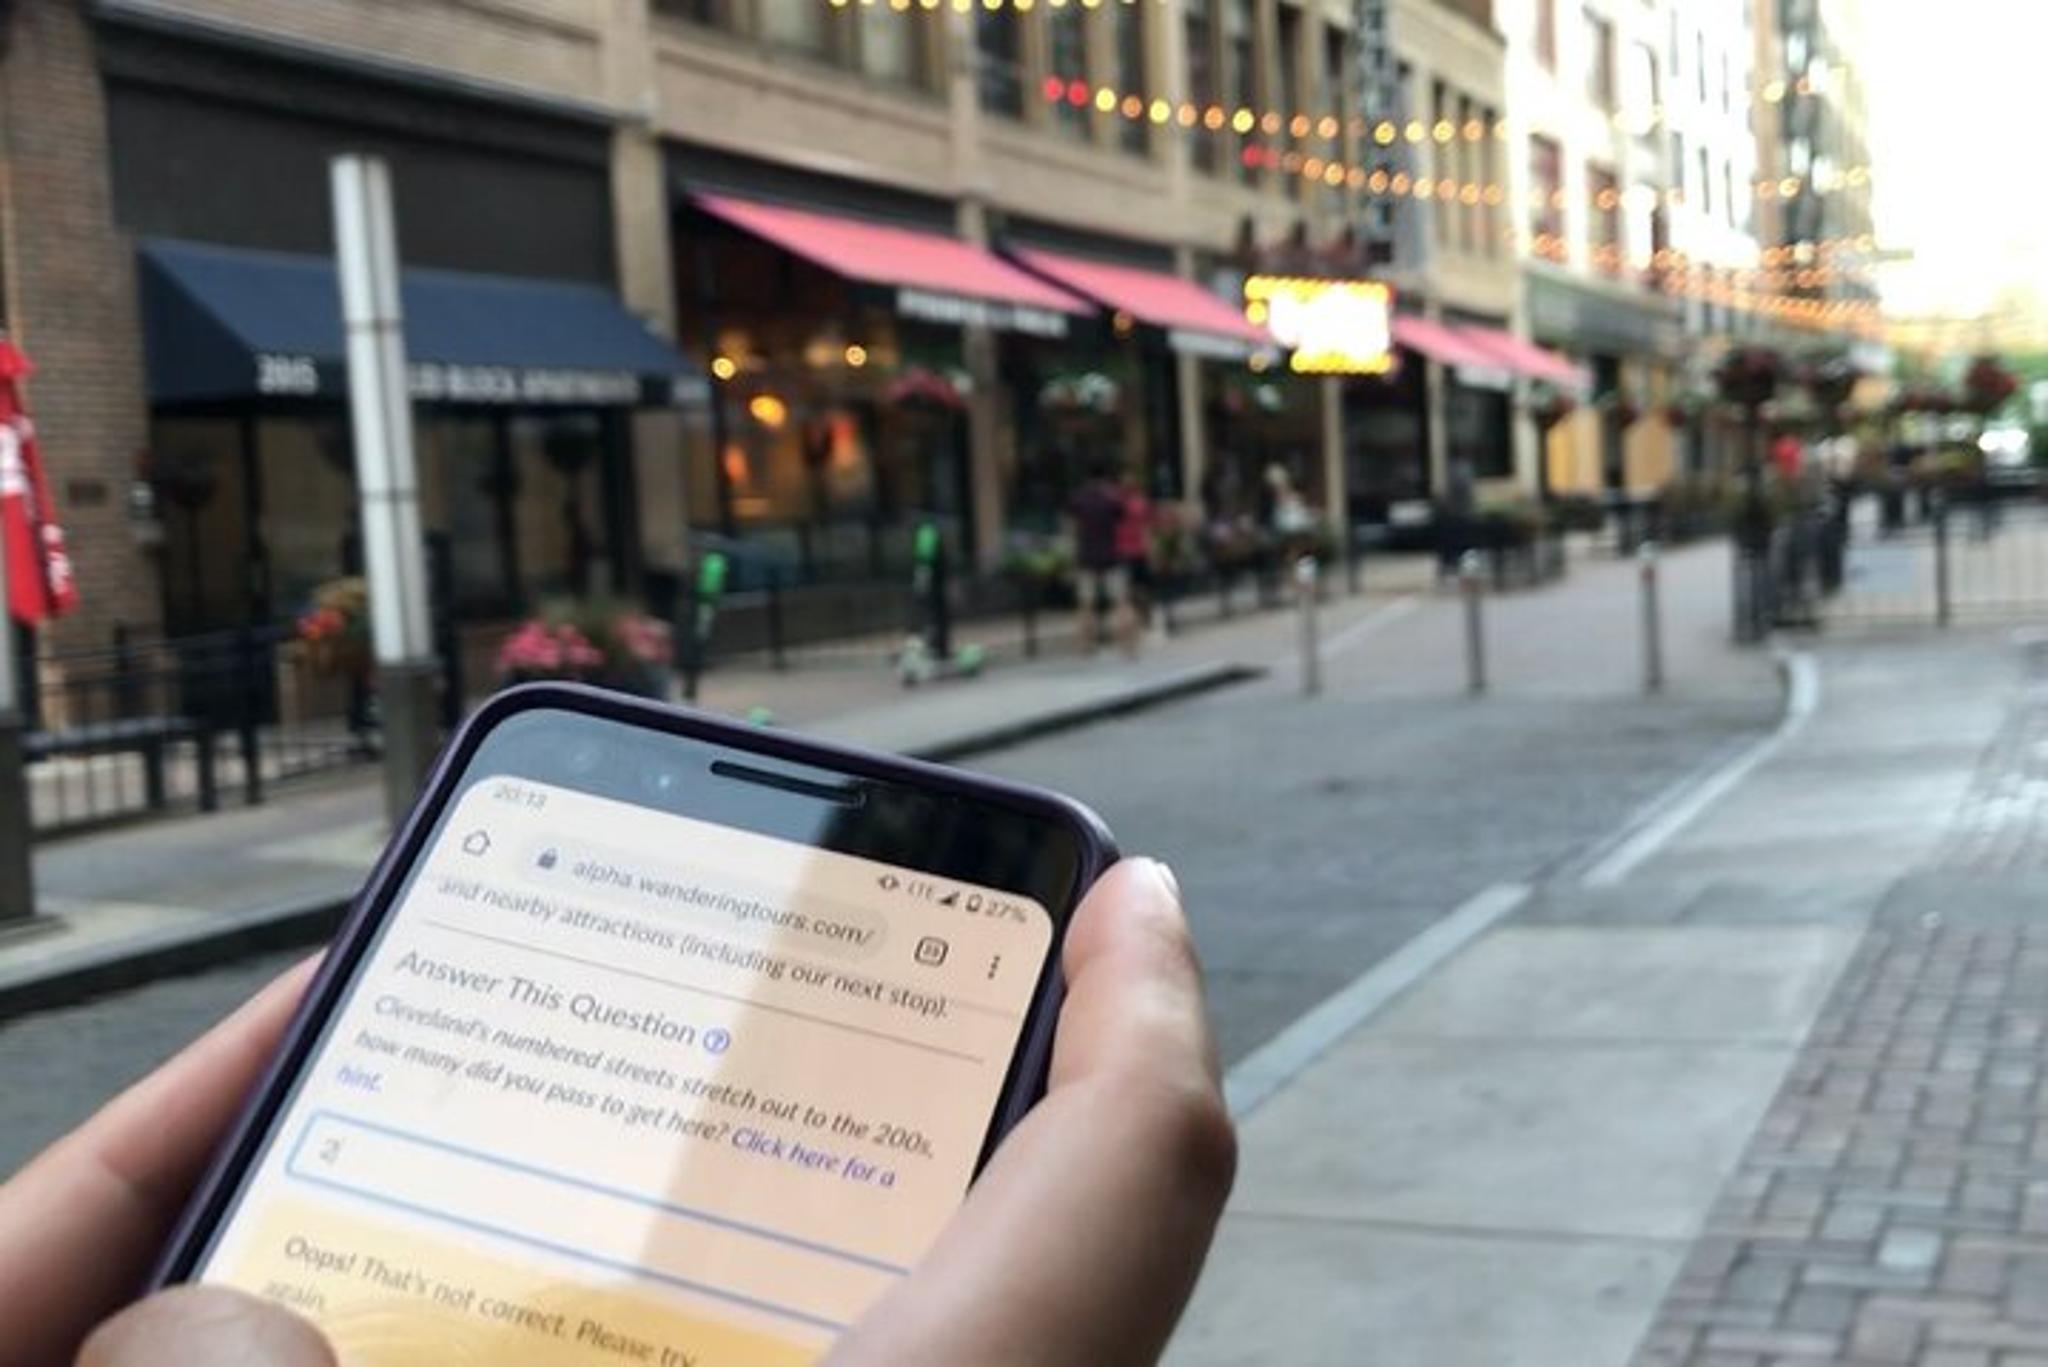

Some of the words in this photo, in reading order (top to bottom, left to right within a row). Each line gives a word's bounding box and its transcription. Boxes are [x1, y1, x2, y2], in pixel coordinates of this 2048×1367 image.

[438, 877, 481, 900] and
[482, 886, 556, 922] nearby
[559, 906, 675, 950] attractions
[680, 932, 784, 980] (including
[791, 966, 830, 987] our
[833, 974, 884, 1000] next
[889, 986, 948, 1019] stop).
[986, 900, 1027, 924] 27%
[394, 951, 503, 994] Answer
[503, 976, 565, 1011] This
[569, 993, 696, 1046] Question
[336, 1064, 383, 1093] hint.
[355, 1028, 402, 1056] how
[402, 1045, 465, 1073] many
[465, 1060, 505, 1083] did
[503, 1069, 546, 1096] you
[545, 1080, 596, 1107] pass
[600, 1093, 625, 1116] to
[623, 1103, 665, 1130] get
[666, 1108, 732, 1142] here?
[731, 1126, 789, 1159] Click
[788, 1141, 841, 1172] here
[842, 1155, 877, 1182] for
[879, 1170, 897, 1187] a
[374, 995, 490, 1042] Cleveland's
[491, 1027, 604, 1070] numbered
[605, 1057, 676, 1089] streets
[681, 1077, 758, 1109] stretch
[760, 1097, 799, 1122] out
[802, 1106, 828, 1129] to
[830, 1114, 870, 1139] the
[873, 1122, 935, 1160] 200s,
[283, 1235, 358, 1273] Oops!
[360, 1255, 430, 1294] That's
[432, 1282, 477, 1313] not
[478, 1297, 568, 1340] correct.
[575, 1317, 656, 1363] Please
